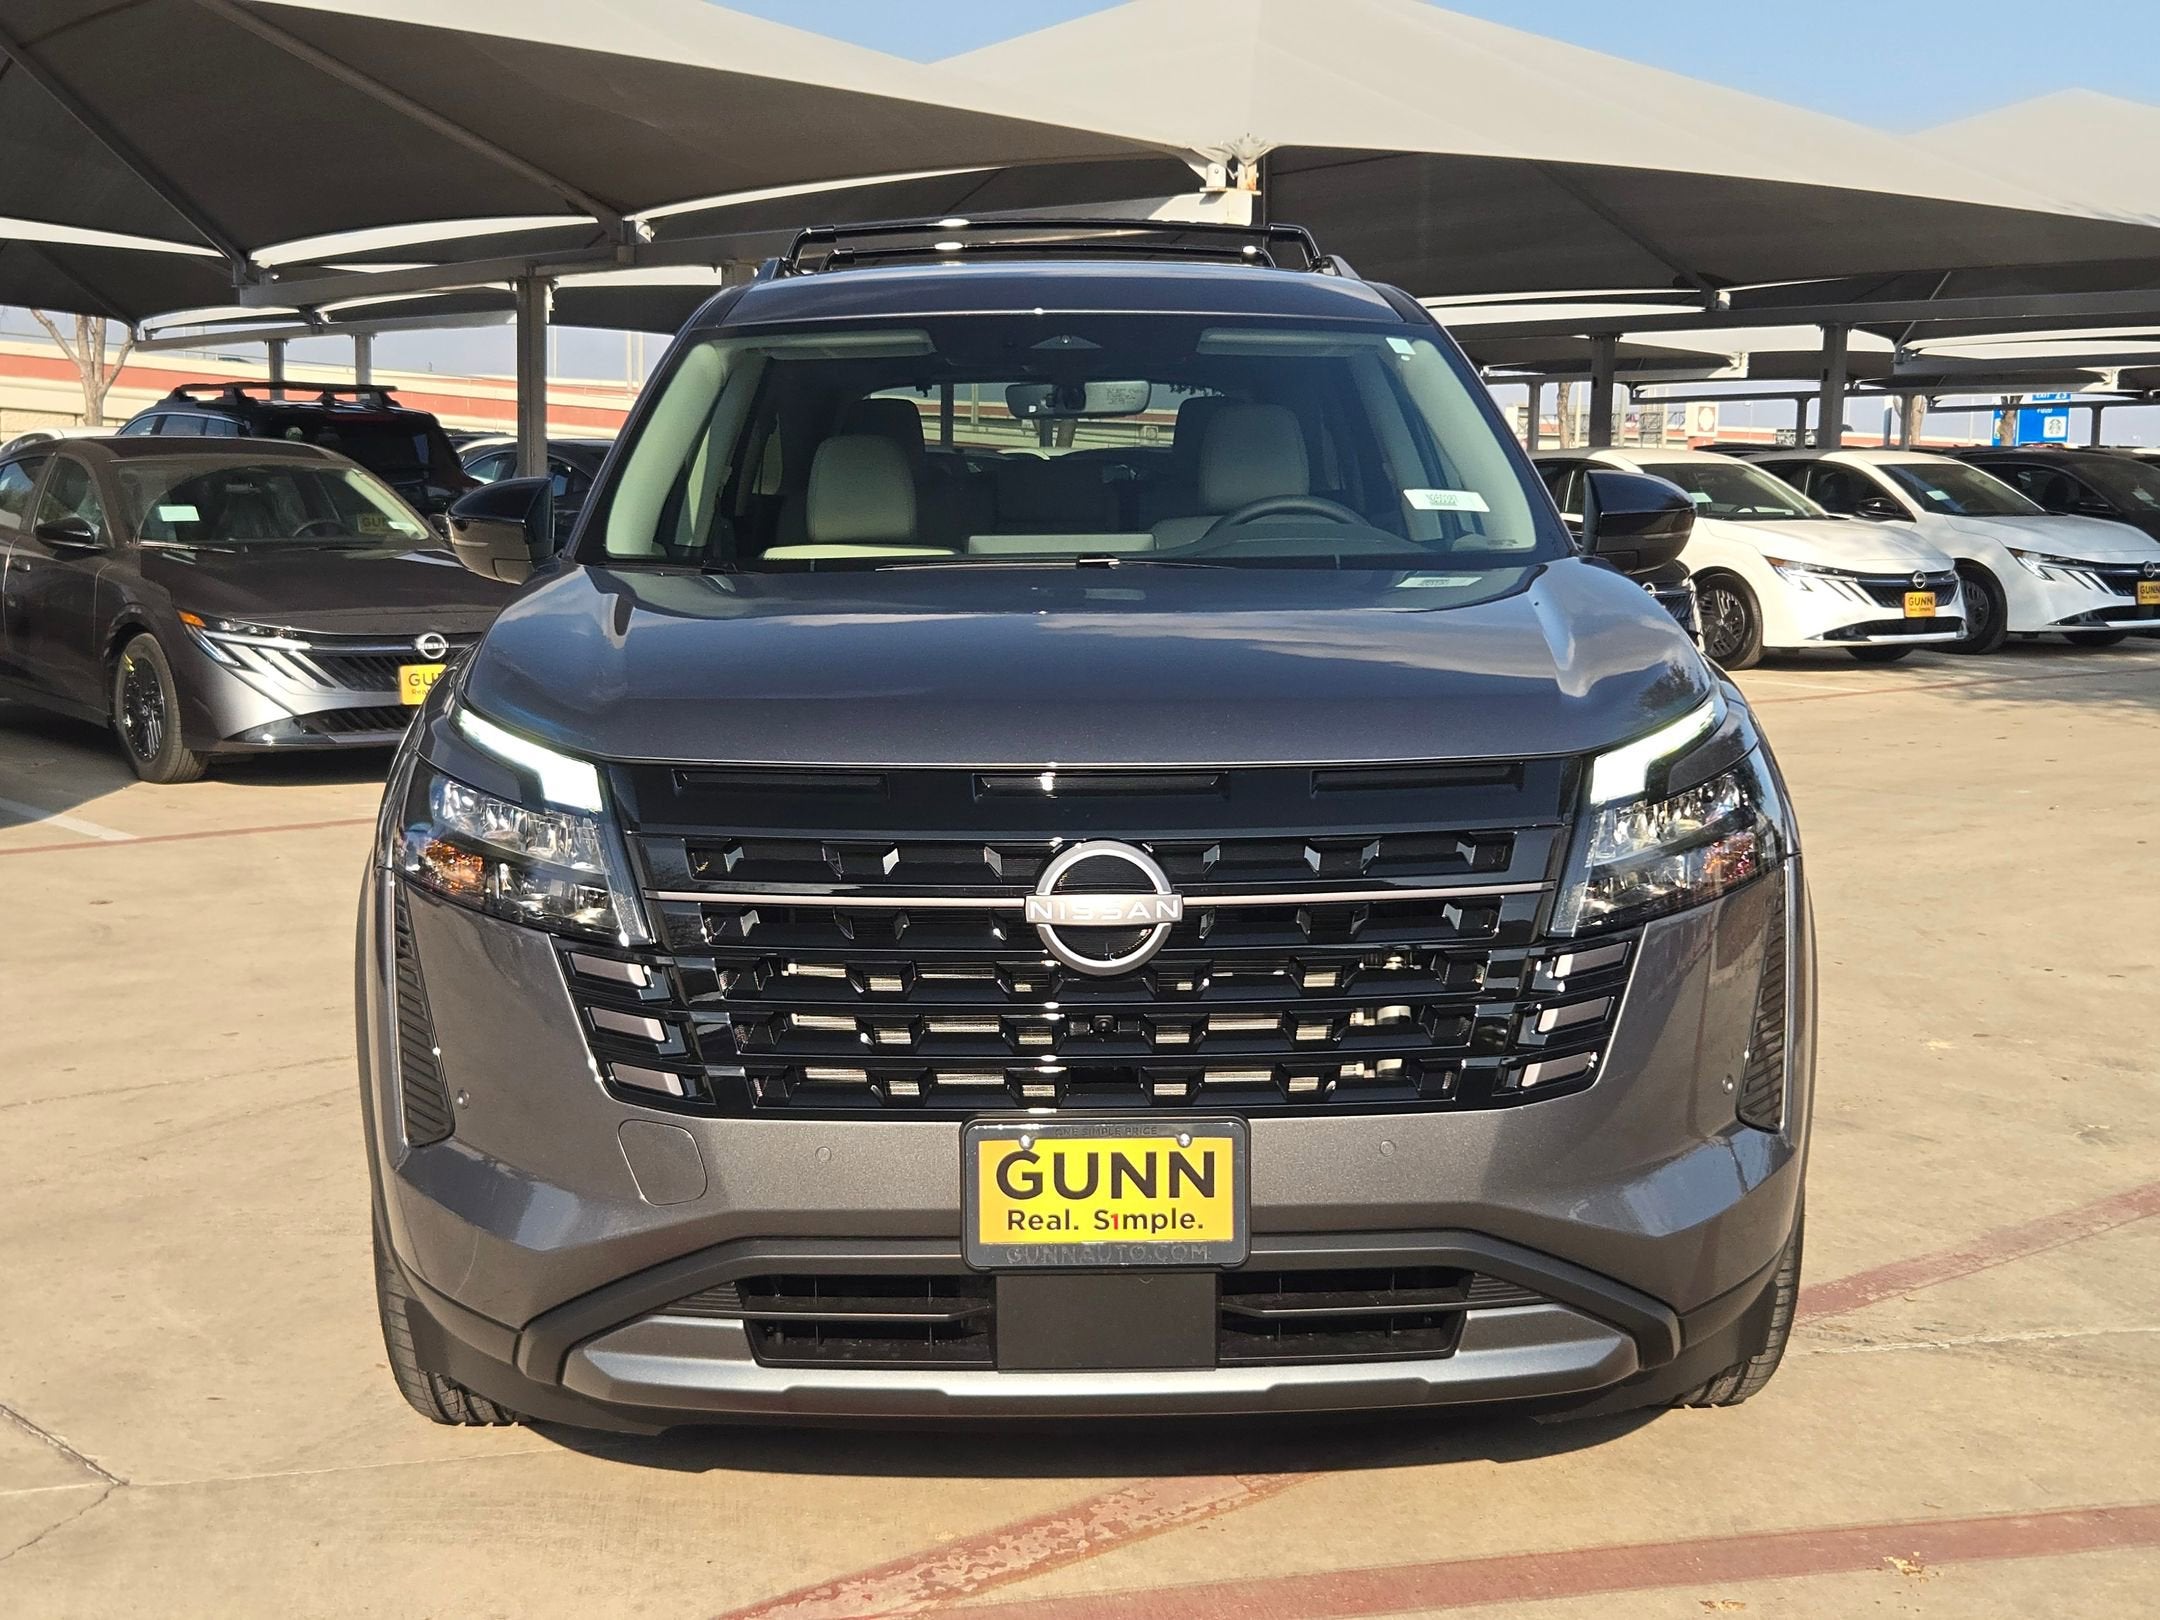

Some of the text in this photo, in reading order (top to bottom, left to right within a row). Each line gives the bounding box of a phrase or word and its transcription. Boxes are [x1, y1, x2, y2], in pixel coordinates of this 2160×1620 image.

[1908, 596, 1933, 606] GUNN
[1029, 899, 1179, 920] NISSAN
[1055, 1126, 1158, 1137] ONE SIMPLE PRICE
[996, 1150, 1215, 1200] GUNN
[1007, 1209, 1079, 1231] Real.
[1006, 1244, 1209, 1264] GUNNAUTO.COM
